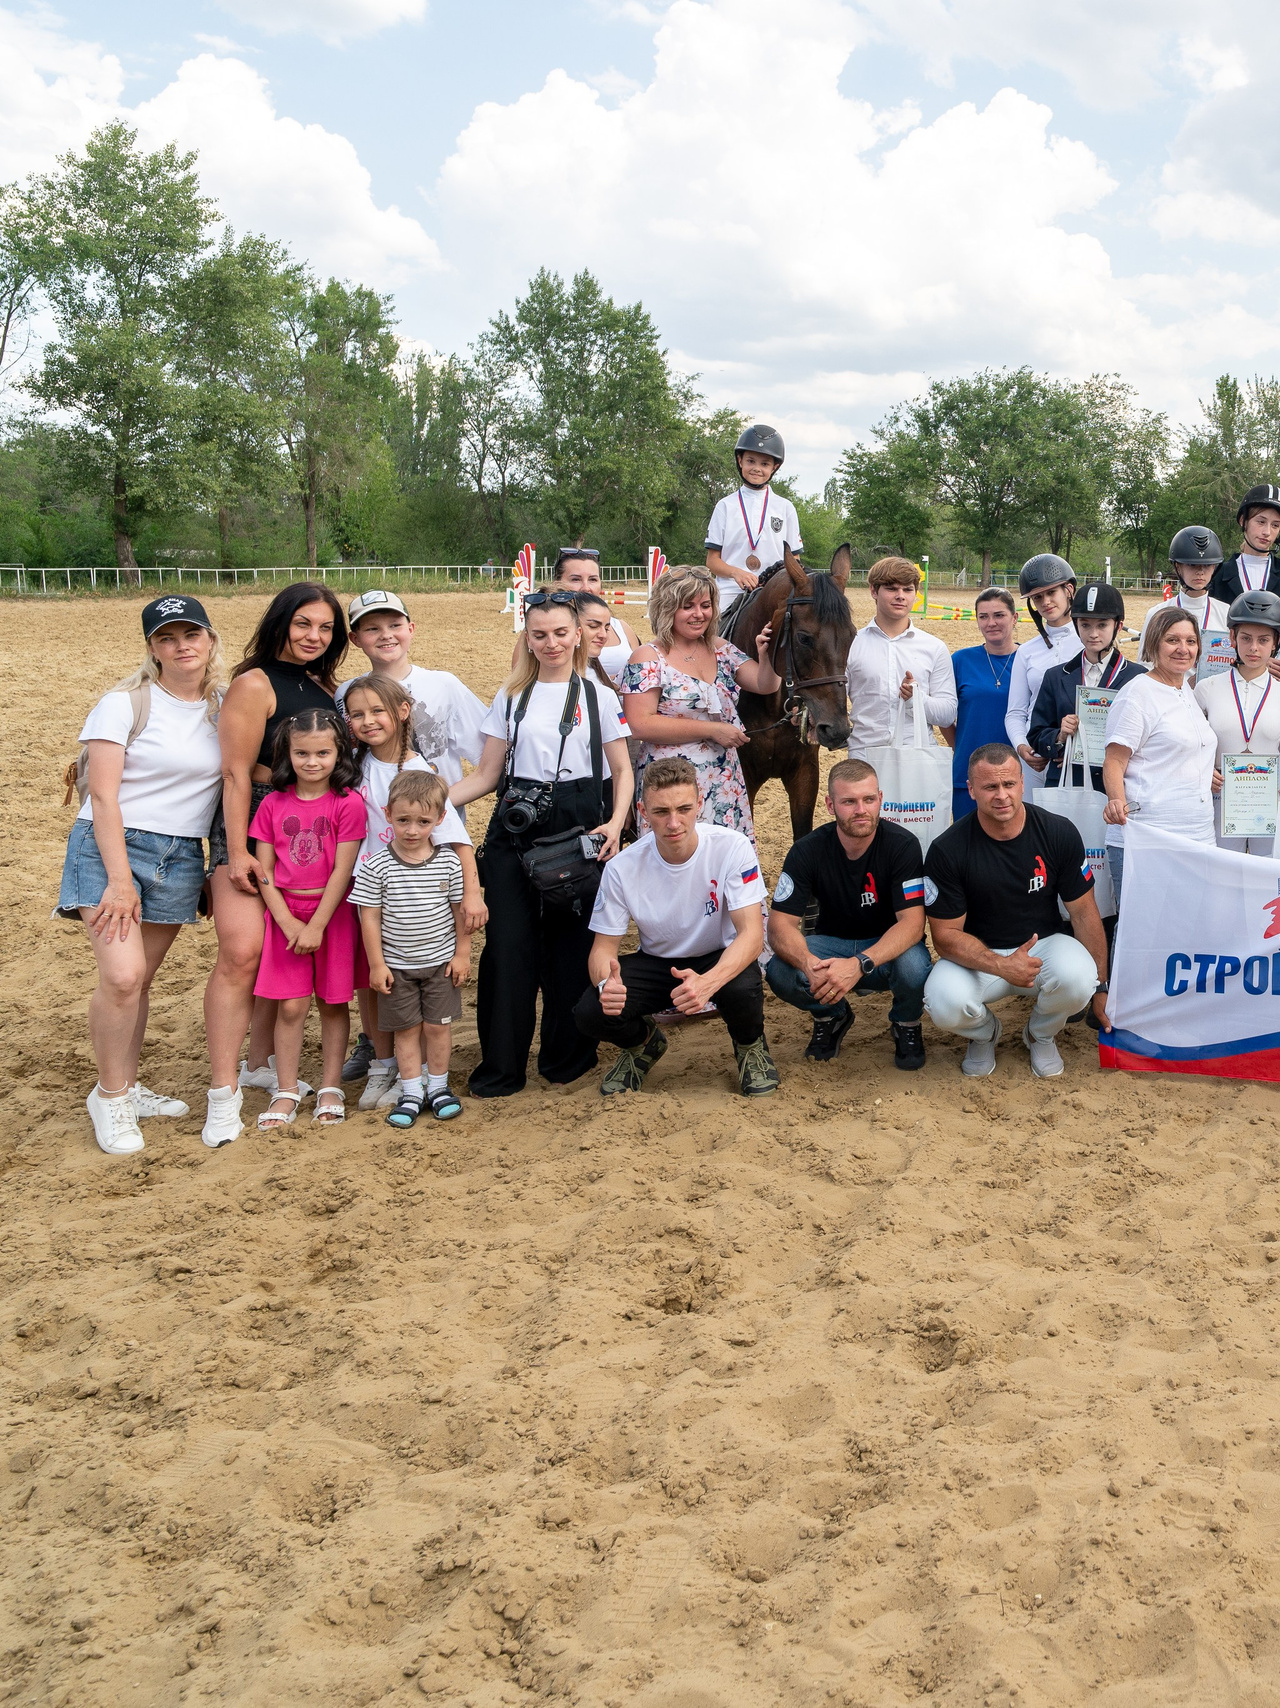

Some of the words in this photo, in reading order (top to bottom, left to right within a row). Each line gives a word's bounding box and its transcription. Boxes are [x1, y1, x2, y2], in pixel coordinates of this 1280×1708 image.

[1207, 655, 1236, 664] ДИПЛО
[883, 800, 936, 813] СТРОЙЦЕНТР
[903, 815, 934, 823] вместе!
[1028, 875, 1045, 894] ДВ
[861, 892, 876, 907] ДВ
